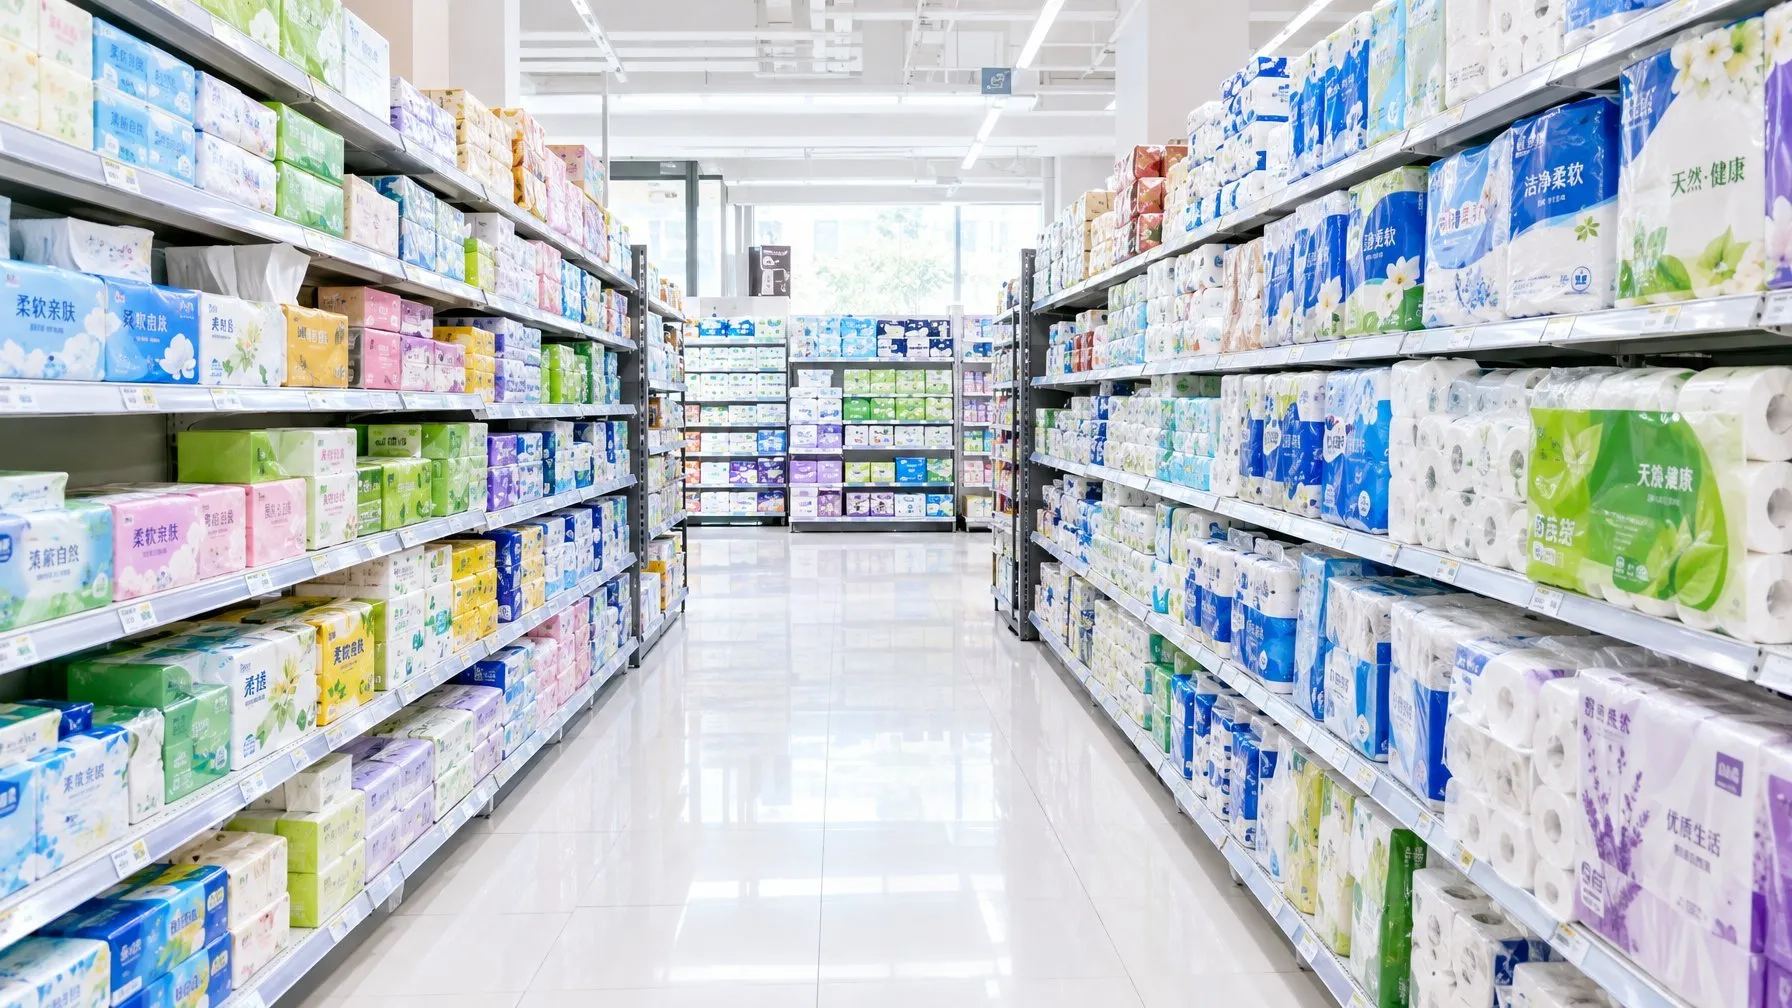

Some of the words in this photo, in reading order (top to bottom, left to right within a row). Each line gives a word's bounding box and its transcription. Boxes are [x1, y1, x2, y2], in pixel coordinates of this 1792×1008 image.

[1524, 161, 1584, 198] 洁净柔软
[16, 294, 76, 322] 柔软亲肤
[1667, 808, 1721, 858] 优质生活
